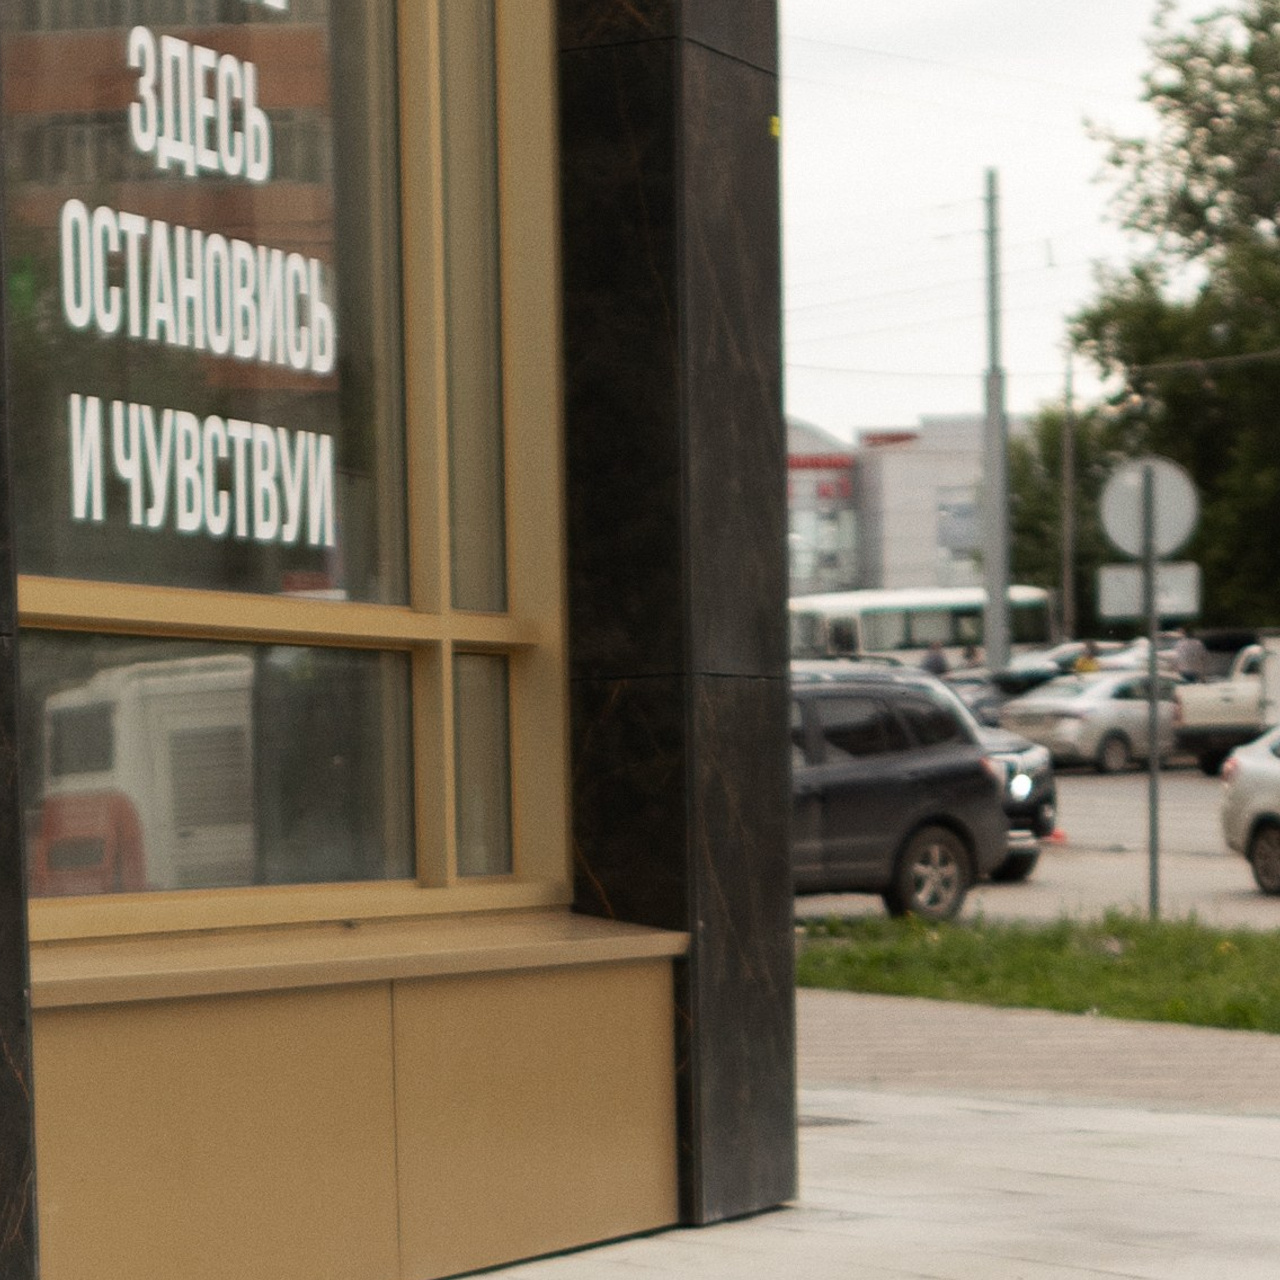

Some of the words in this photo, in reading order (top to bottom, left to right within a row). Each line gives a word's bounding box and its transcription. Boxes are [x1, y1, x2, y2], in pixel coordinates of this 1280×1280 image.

[128, 25, 271, 183] ЗДЕСЬ
[61, 199, 335, 373] ОСТАНОВИСЬ
[70, 393, 104, 521] И
